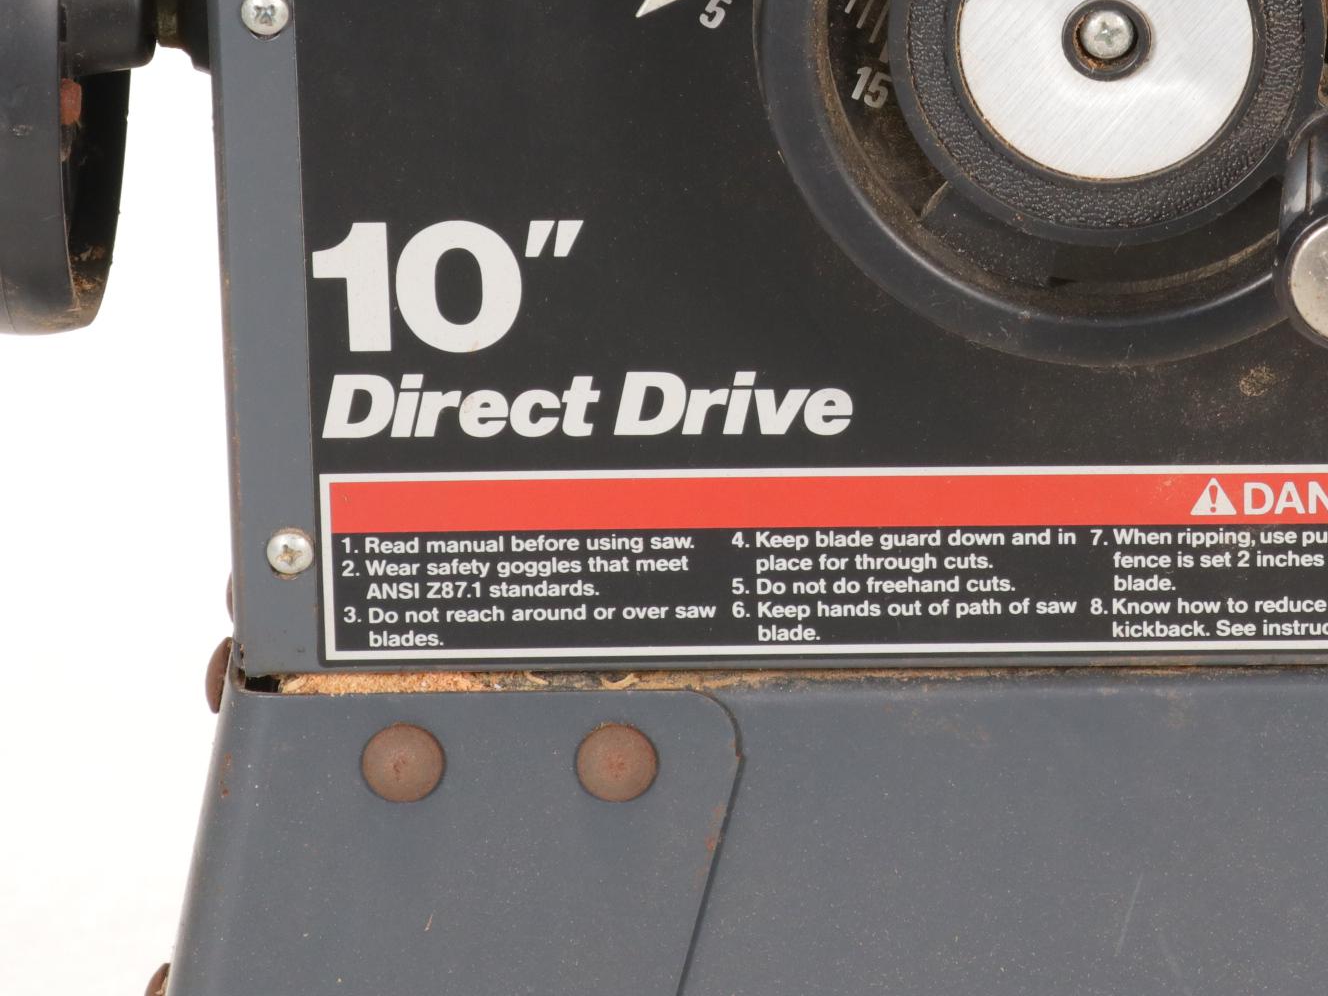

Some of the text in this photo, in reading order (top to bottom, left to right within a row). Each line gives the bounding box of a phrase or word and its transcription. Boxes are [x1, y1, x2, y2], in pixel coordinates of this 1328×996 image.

[850, 65, 893, 108] 15
[322, 371, 853, 438] Direct Drive
[341, 533, 695, 555] 1. Read manual before using saw.
[731, 527, 1077, 551] 4. Keep blade guard down and in
[1089, 528, 1109, 546] 7.
[1112, 527, 1173, 546] When
[1177, 527, 1256, 548] ripping,
[1259, 530, 1298, 545] use
[341, 555, 689, 579] 2. Wear safety goggles that meet
[755, 552, 994, 575] place for through cuts.
[1112, 550, 1172, 569] fence
[1176, 550, 1195, 569] is
[1199, 551, 1232, 568] set
[1236, 549, 1251, 568] 2
[1256, 549, 1325, 568] inches
[366, 579, 600, 600] ANSI Z87.1 standards.
[731, 575, 1016, 595] 5. Do not do freehand cuts.
[1113, 573, 1177, 592] blade.
[343, 603, 717, 624] 3. Do not reach around or over saw
[731, 597, 1078, 622] 6. Keep hands out of path of saw
[1089, 597, 1109, 616] 8.
[1111, 597, 1172, 615] Know
[1177, 597, 1222, 615] how
[1226, 597, 1249, 614] to
[1254, 595, 1328, 614] reduce
[368, 629, 445, 648] blades.
[757, 623, 821, 642] blade.
[1112, 619, 1211, 638] kickback.
[1215, 619, 1257, 637] See
